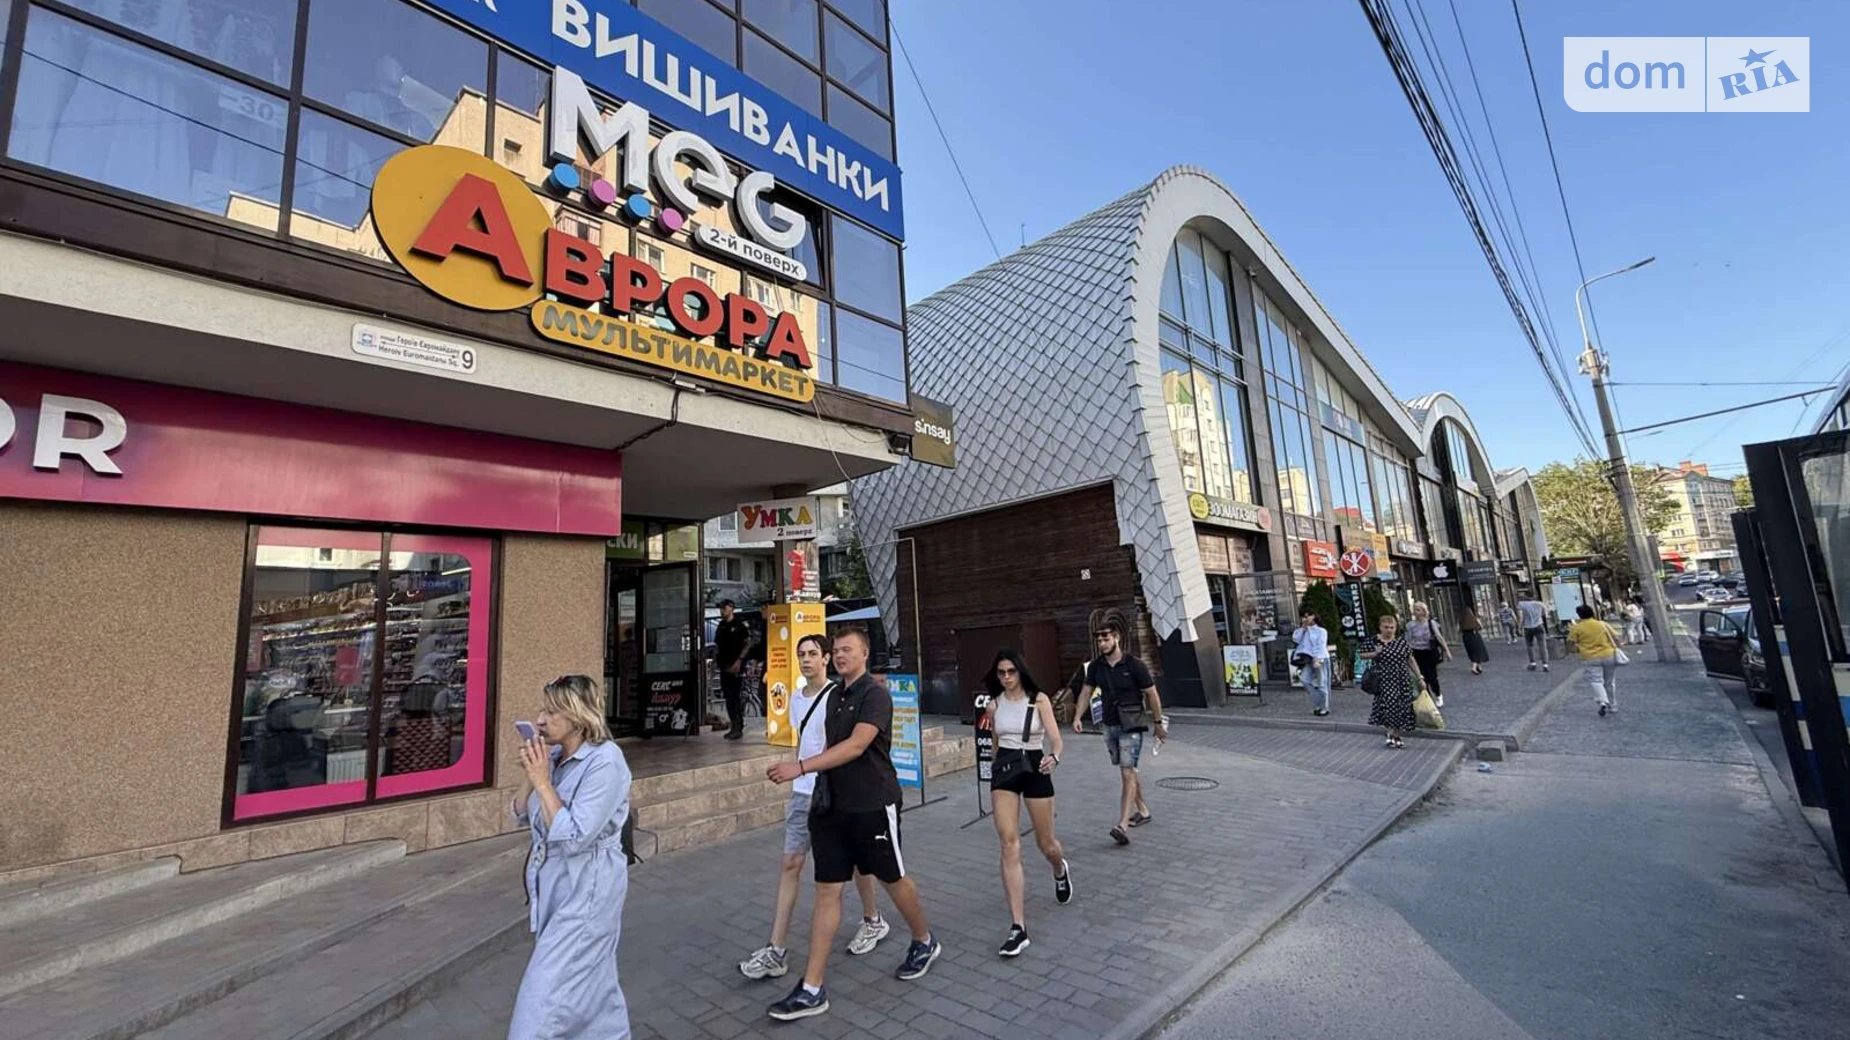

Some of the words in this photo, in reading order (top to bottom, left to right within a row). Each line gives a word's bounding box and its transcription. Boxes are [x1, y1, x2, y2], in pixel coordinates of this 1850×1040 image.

[552, 0, 889, 212] ВИШИВАНКИ
[710, 228, 738, 250] 2-й
[743, 244, 800, 276] поверх
[462, 350, 474, 369] 9
[541, 304, 809, 396] МУЛЬТИМАРКЕТ
[0, 393, 127, 476] R
[915, 418, 951, 445] sinsay
[741, 504, 813, 530] УМКА
